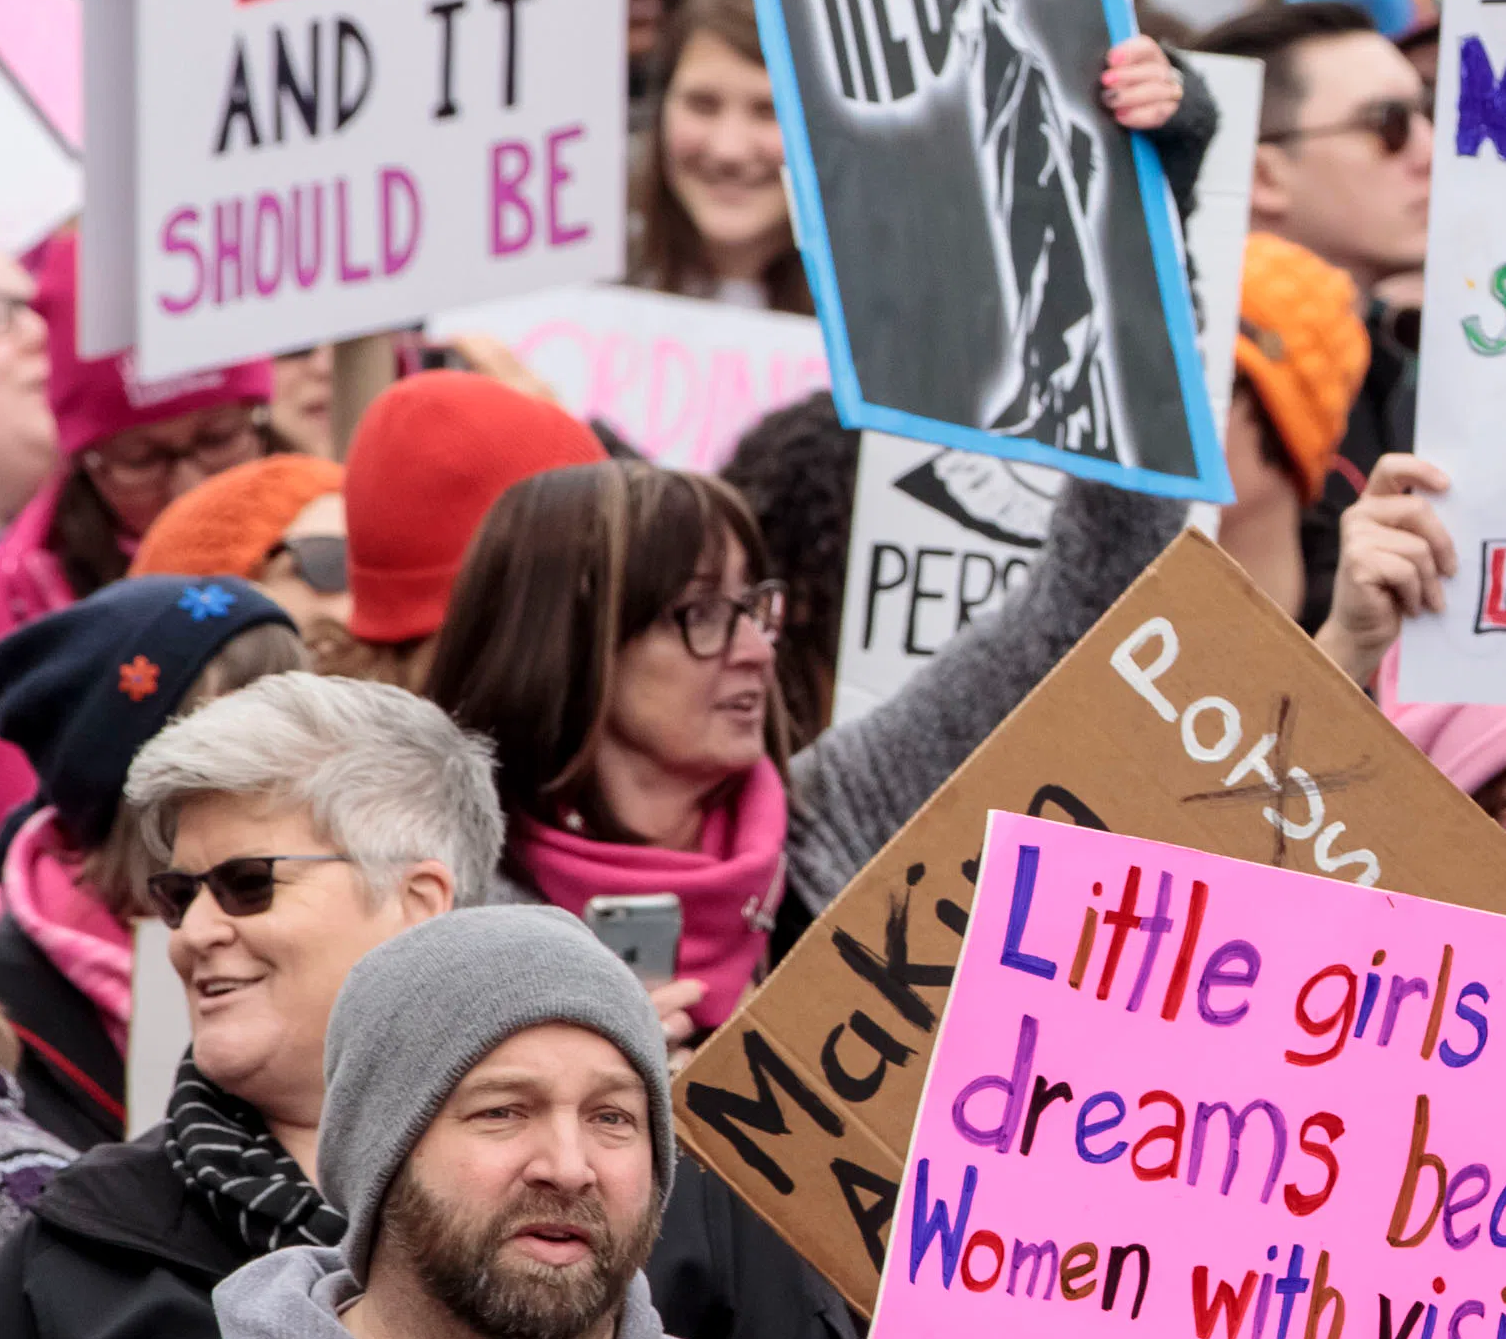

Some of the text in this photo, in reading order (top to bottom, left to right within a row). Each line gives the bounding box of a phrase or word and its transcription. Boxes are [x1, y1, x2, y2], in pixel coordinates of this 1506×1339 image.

[213, 14, 374, 159] AND
[157, 127, 591, 318] SHOULD BE
[998, 843, 1263, 1029] Little
[1282, 942, 1492, 1071] girls
[950, 1011, 1348, 1218] dreams
[907, 1155, 1152, 1323] Women
